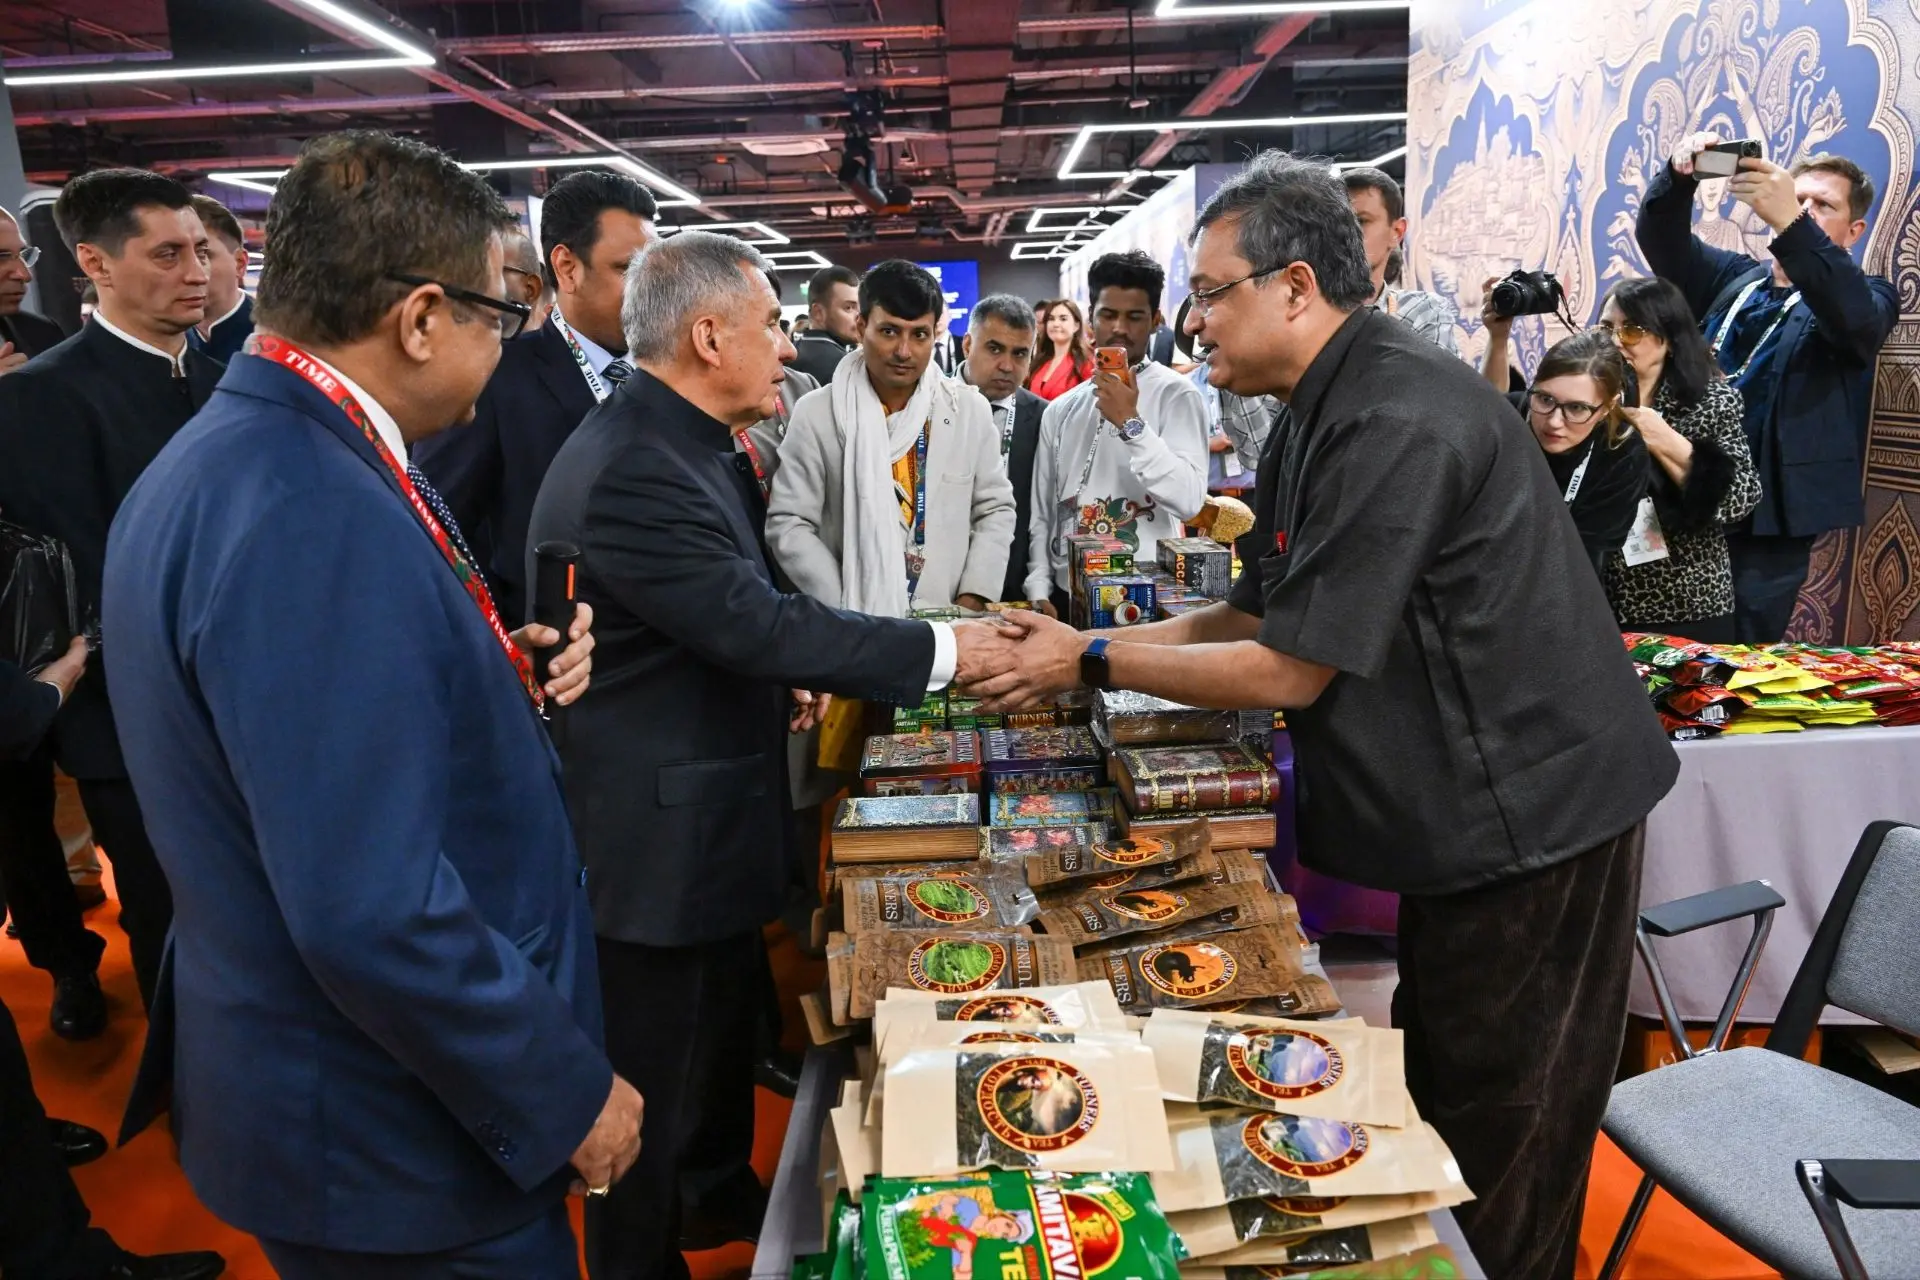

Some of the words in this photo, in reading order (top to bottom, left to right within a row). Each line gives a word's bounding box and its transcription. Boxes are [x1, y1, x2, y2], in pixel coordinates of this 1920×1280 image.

[285, 350, 338, 393] TIME
[584, 368, 603, 394] TIME
[410, 487, 441, 536] TIME
[489, 609, 515, 654] TIME
[1007, 711, 1055, 723] TURNERS
[909, 948, 931, 988] TURNERS
[1109, 956, 1132, 1004] RNERS
[1320, 1044, 1344, 1088] TURNERS
[1074, 1071, 1099, 1132] TURNERS
[1271, 1085, 1293, 1096] TEA
[1032, 1138, 1055, 1148] TEA
[1036, 1185, 1081, 1280] AMITAV
[999, 1245, 1029, 1280] TE
